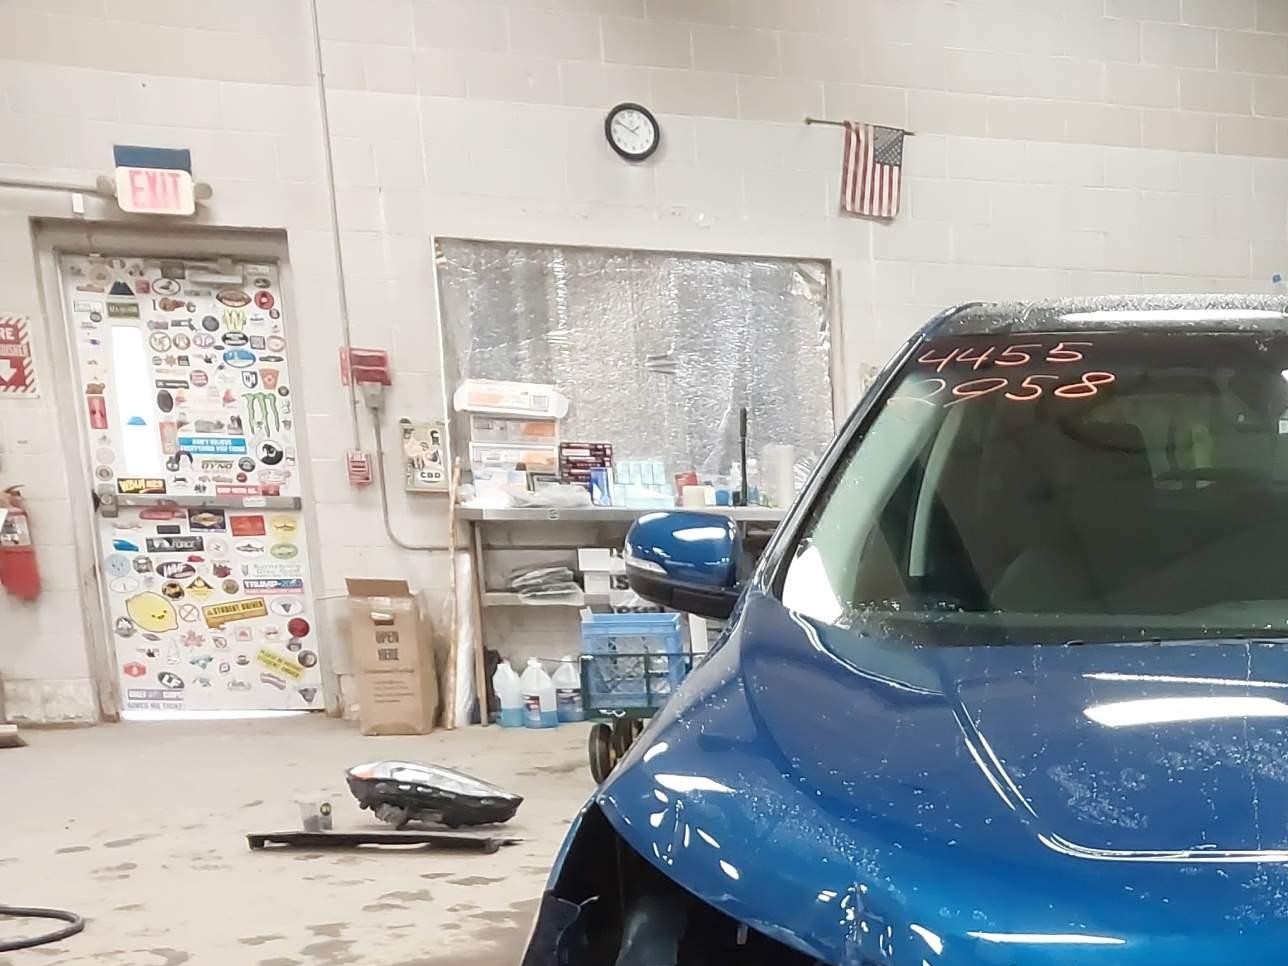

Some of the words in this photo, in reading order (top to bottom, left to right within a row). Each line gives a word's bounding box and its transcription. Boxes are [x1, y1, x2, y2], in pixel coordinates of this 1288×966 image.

[129, 170, 182, 210] EXIT
[0, 327, 15, 340] RE
[918, 342, 1093, 373] 4455
[886, 371, 1115, 408] 2958
[420, 471, 441, 479] CBD
[375, 631, 399, 644] OPEN
[377, 648, 400, 661] HERE
